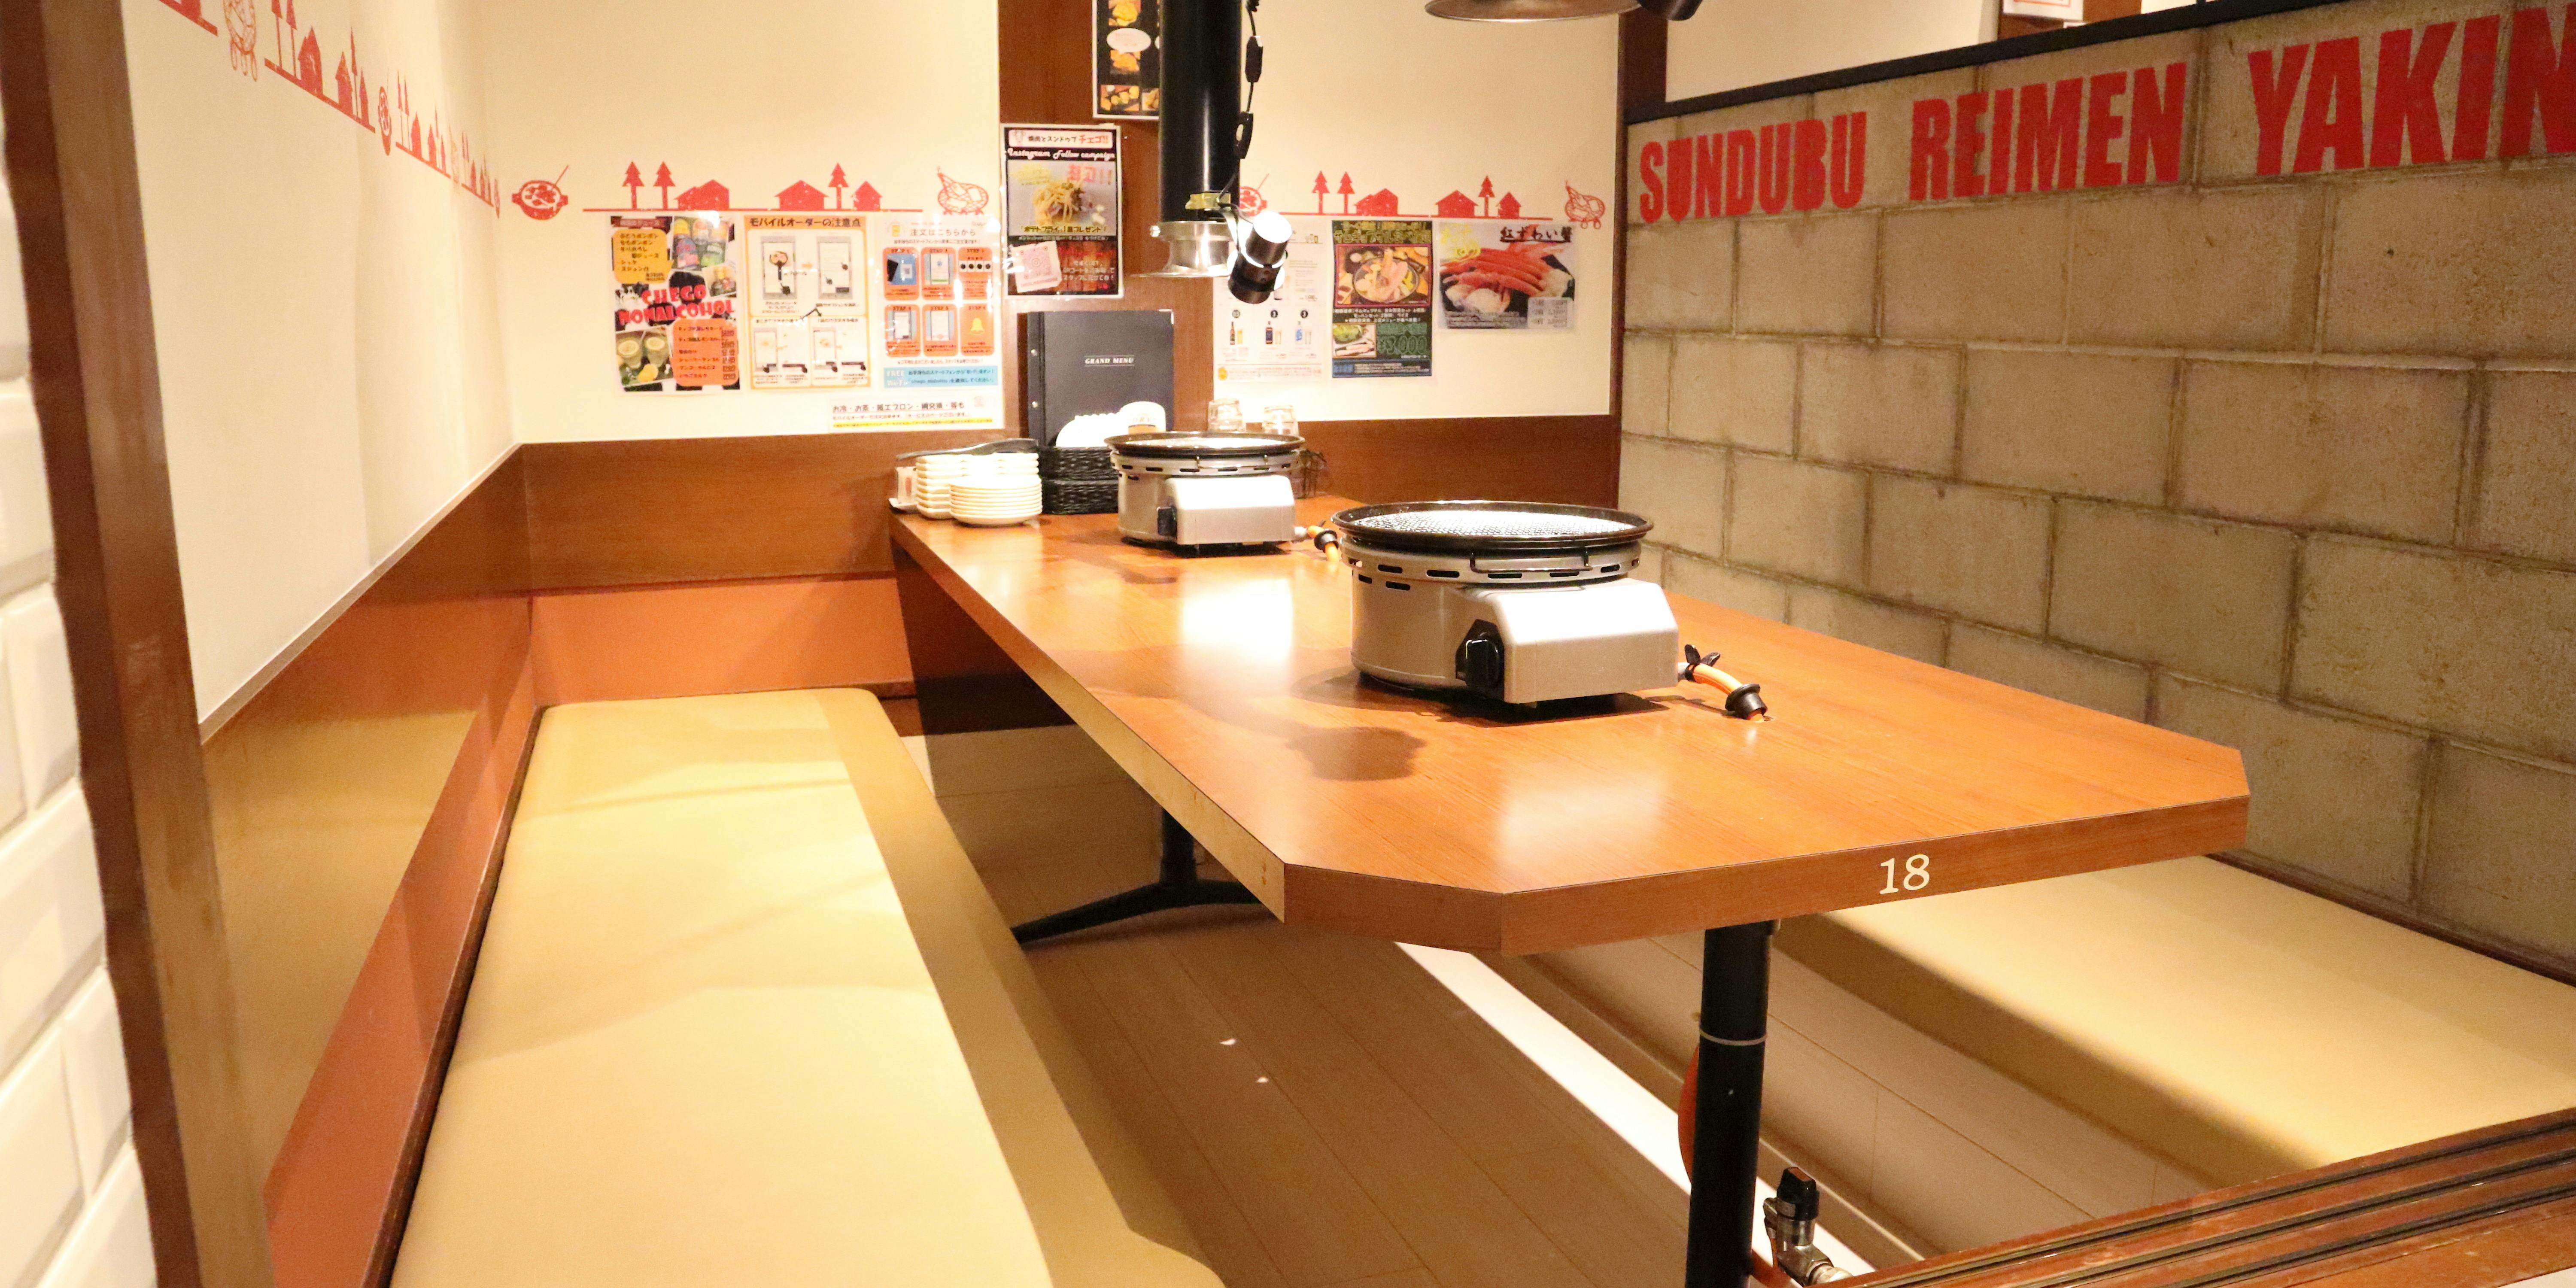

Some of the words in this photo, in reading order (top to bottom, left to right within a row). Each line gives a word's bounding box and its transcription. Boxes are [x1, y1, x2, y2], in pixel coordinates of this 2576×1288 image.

[1640, 111, 1867, 223] SUNDUBU
[1909, 62, 2187, 201] REIMEN
[2248, 2, 2576, 176] YAKIN
[1007, 147, 1051, 160] Instagram
[1052, 149, 1080, 160] Follow
[750, 218, 861, 228] モバイルオーダーの注意点
[641, 284, 706, 305] CHEGO
[1879, 854, 1930, 894] 18
